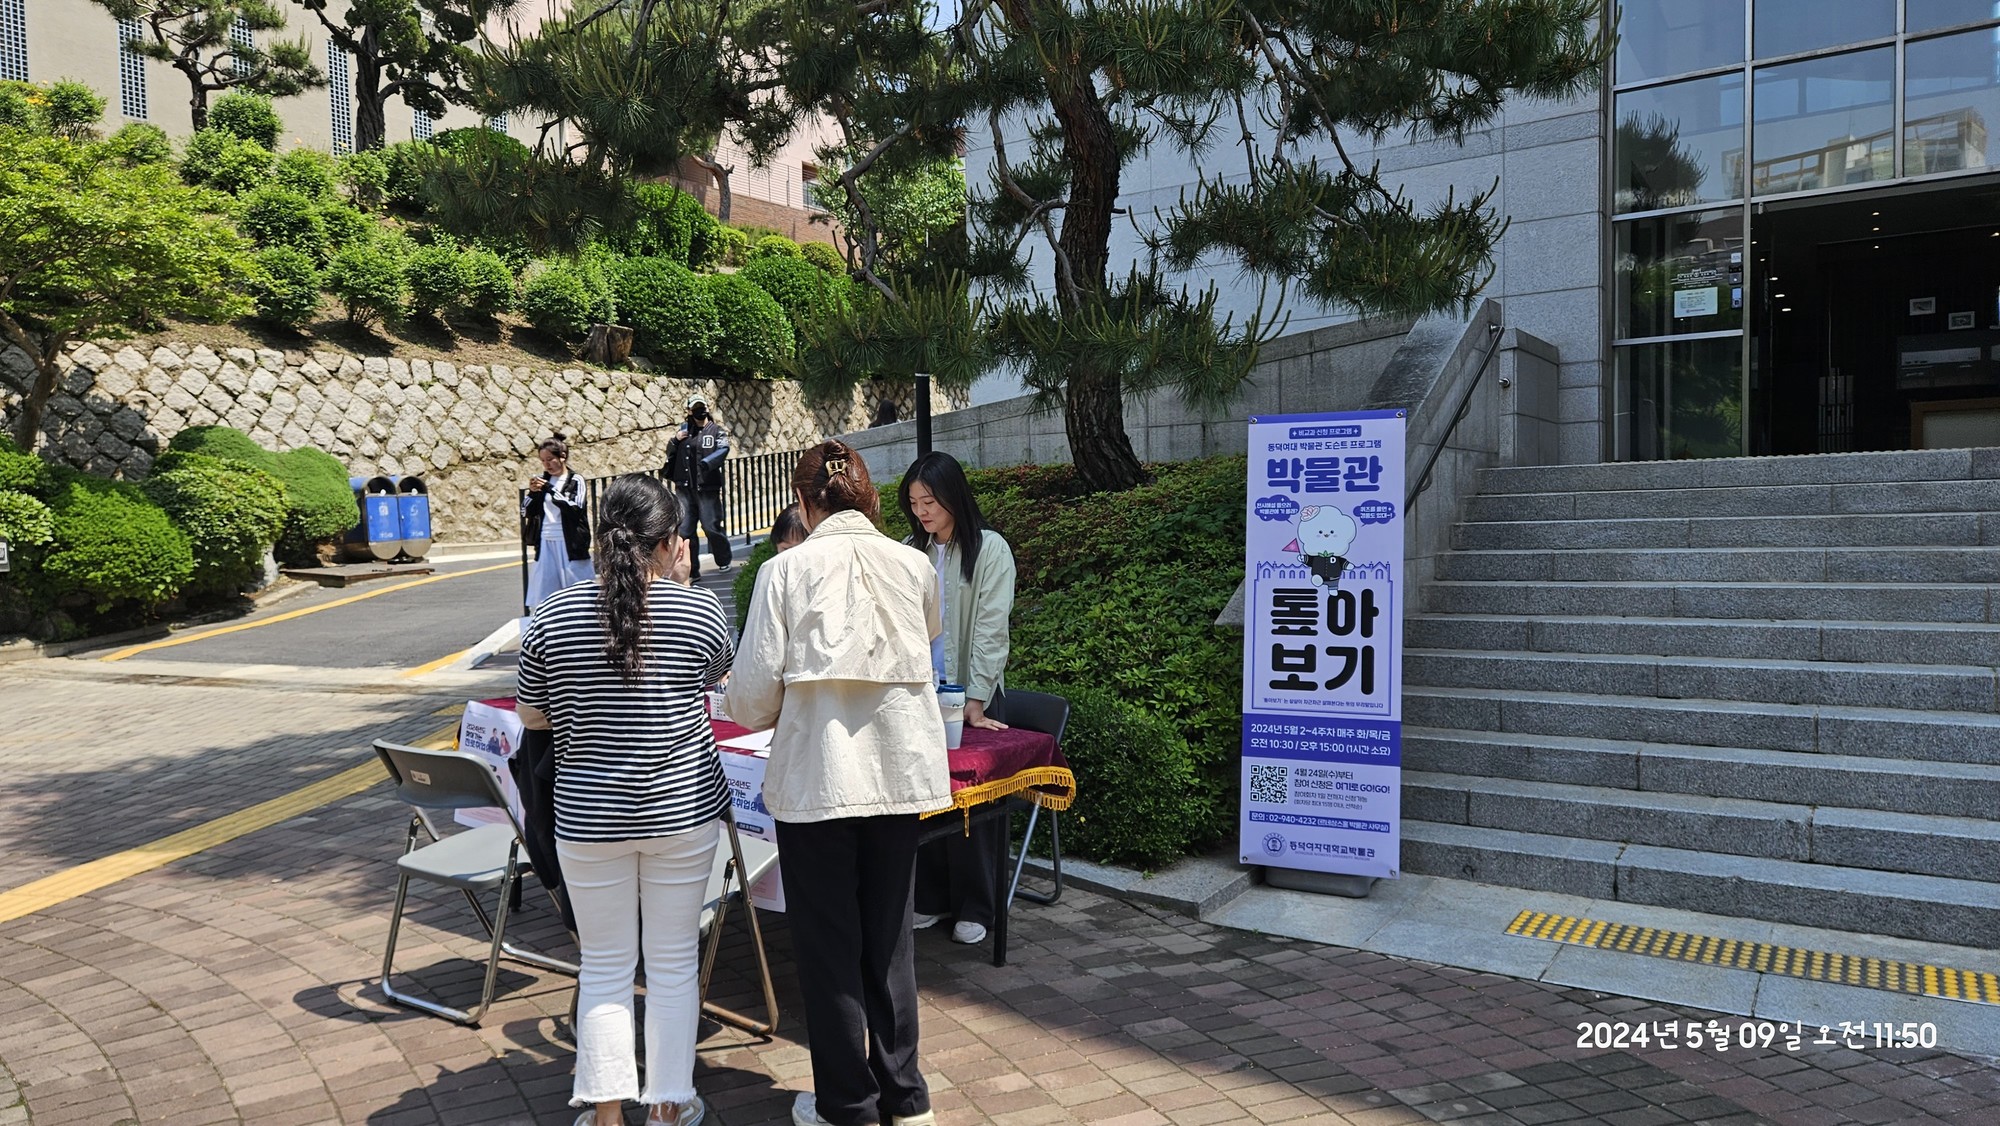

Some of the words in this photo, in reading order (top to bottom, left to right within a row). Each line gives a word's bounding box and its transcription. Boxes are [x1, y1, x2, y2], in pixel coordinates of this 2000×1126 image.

[1316, 428, 1328, 436] 신청
[1329, 427, 1353, 435] 프로그램
[702, 435, 714, 448] D
[1267, 443, 1298, 452] 동덕여대
[1299, 442, 1323, 451] 박물관
[1325, 441, 1348, 450] 도슨트
[1350, 439, 1382, 449] 프로그램
[1266, 455, 1384, 493] 박물관
[1330, 556, 1337, 564] D
[1270, 588, 1380, 638] 톺아
[1268, 642, 1375, 696] 보기
[1251, 723, 1282, 735] 2024년
[1283, 726, 1299, 736] 5월
[1300, 727, 1336, 738] 2~4주차
[1337, 729, 1355, 739] 매주
[1356, 730, 1391, 741] 화/목/금
[1250, 738, 1268, 748] 오전
[1269, 739, 1294, 750] 10:30
[1295, 740, 1299, 751] /
[1300, 741, 1318, 751] 오후
[1319, 742, 1345, 753] 15:00
[1346, 744, 1370, 755] (1시간
[1371, 746, 1391, 756] 소요)
[1294, 768, 1308, 777] 4월
[1308, 768, 1354, 780] 24일(수)부터
[727, 778, 752, 791] 024년도
[1294, 779, 1310, 788] 참여
[1310, 780, 1334, 790] 신청은
[1335, 782, 1359, 792] 여기로
[1360, 783, 1391, 794] GO!GO!
[728, 787, 747, 799] 아가는
[1251, 812, 1265, 821] 문의
[1268, 814, 1317, 826] 02-940-4232
[1349, 821, 1368, 830] 박물관
[1368, 823, 1389, 832] 사무실)
[1289, 840, 1376, 858] 동덕여자대학교박물관
